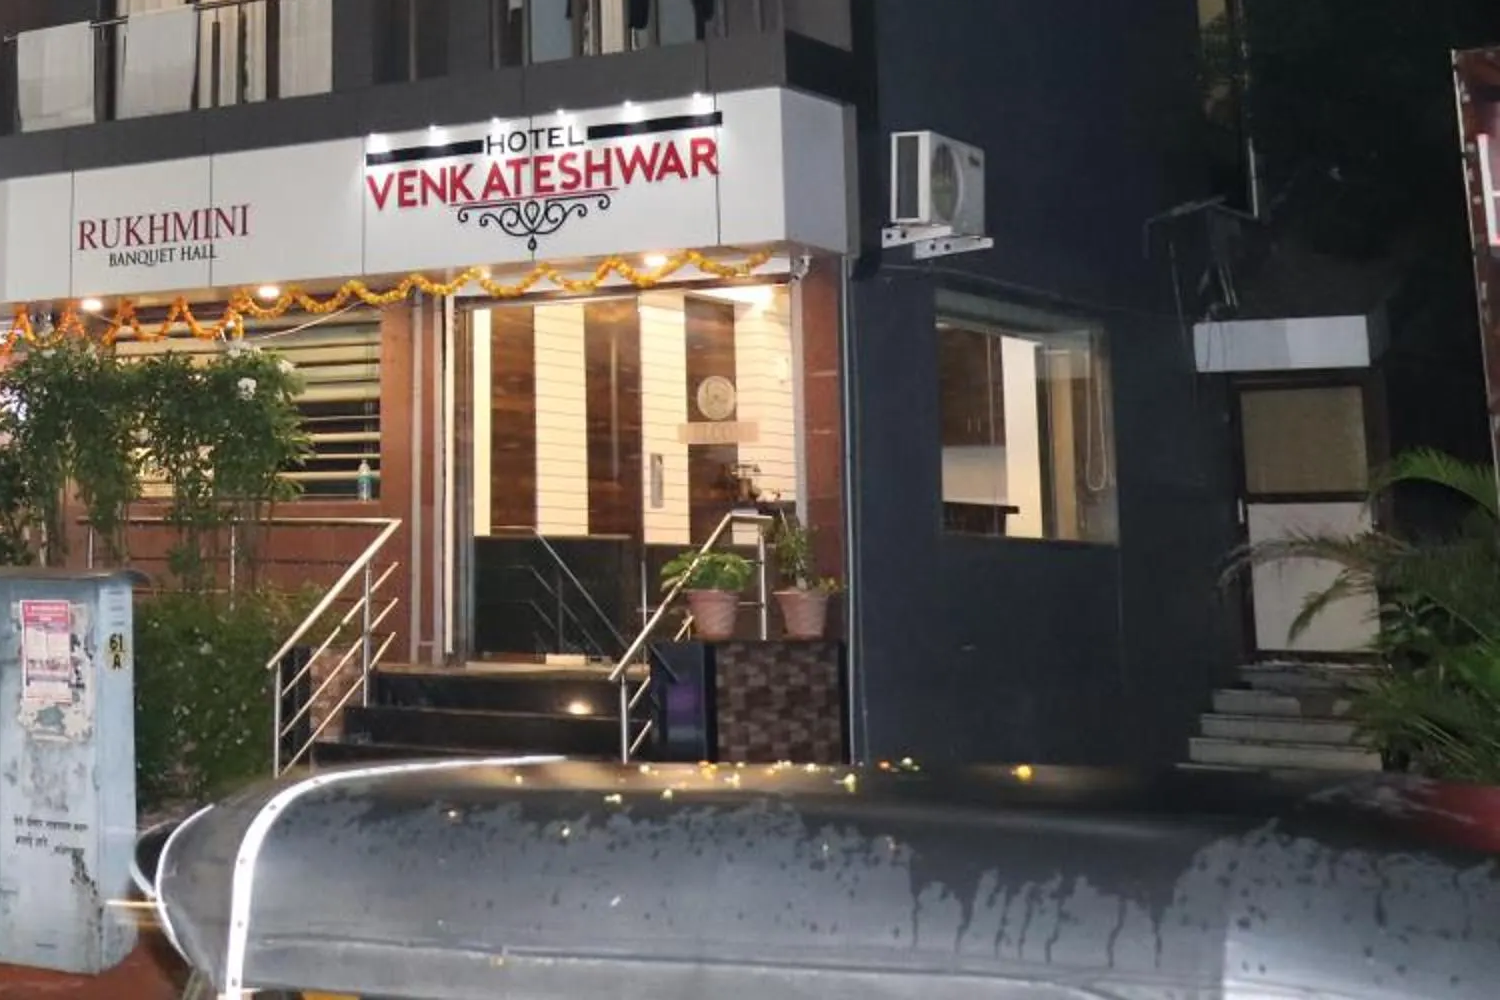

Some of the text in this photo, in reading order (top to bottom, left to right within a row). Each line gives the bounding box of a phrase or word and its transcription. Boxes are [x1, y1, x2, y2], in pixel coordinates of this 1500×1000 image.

[486, 126, 585, 156] HOTEL
[366, 137, 720, 211] VENKATESHWAR
[78, 204, 250, 251] RUKHMINI
[108, 244, 217, 268] BANQUET HALL
[109, 632, 123, 652] 61
